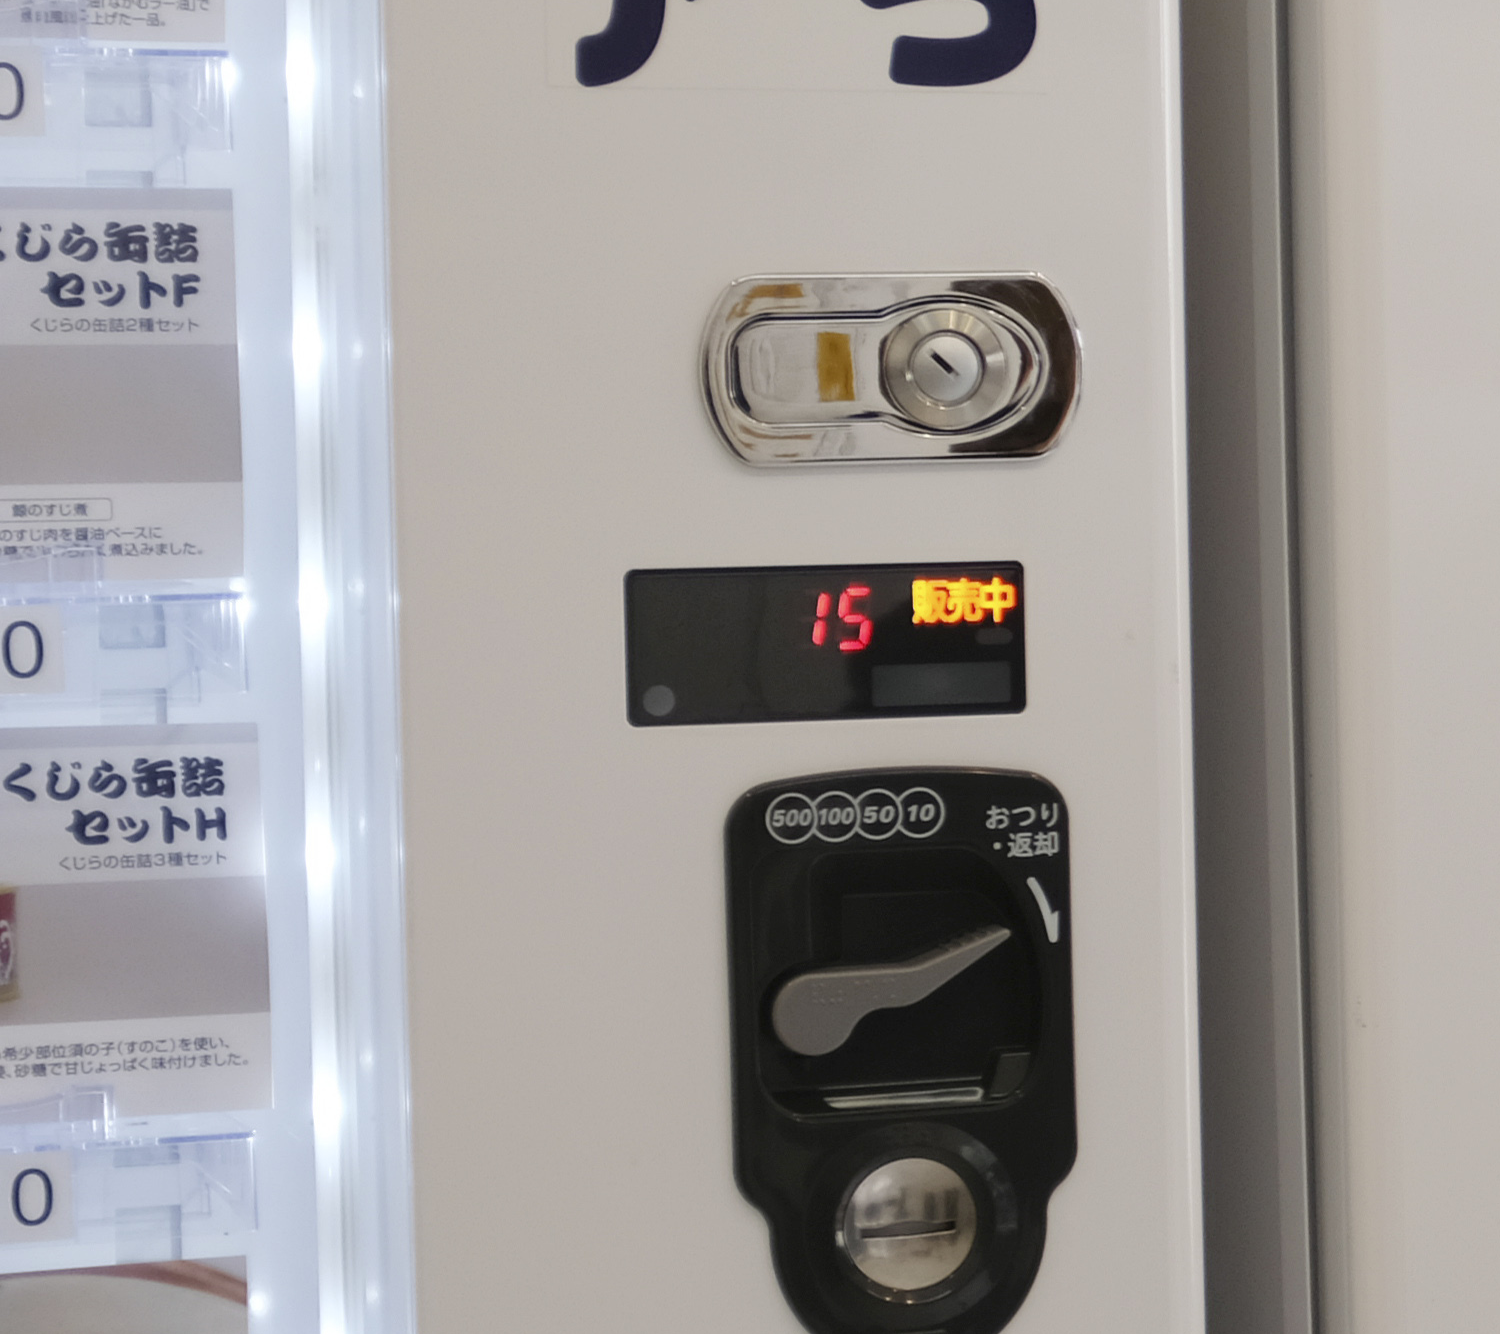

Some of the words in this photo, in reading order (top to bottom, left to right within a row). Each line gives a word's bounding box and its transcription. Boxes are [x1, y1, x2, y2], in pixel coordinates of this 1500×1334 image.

[0, 221, 199, 264] じら缶詰
[40, 270, 201, 309] セットF
[812, 582, 874, 652] 15
[911, 576, 1017, 625] 販売中
[2, 756, 226, 802] くじら缶詰
[65, 805, 228, 846] セットH
[771, 808, 813, 827] 500
[818, 806, 855, 827] 100
[863, 805, 896, 824] 50
[906, 803, 935, 823] 10
[985, 802, 1059, 830] おつり
